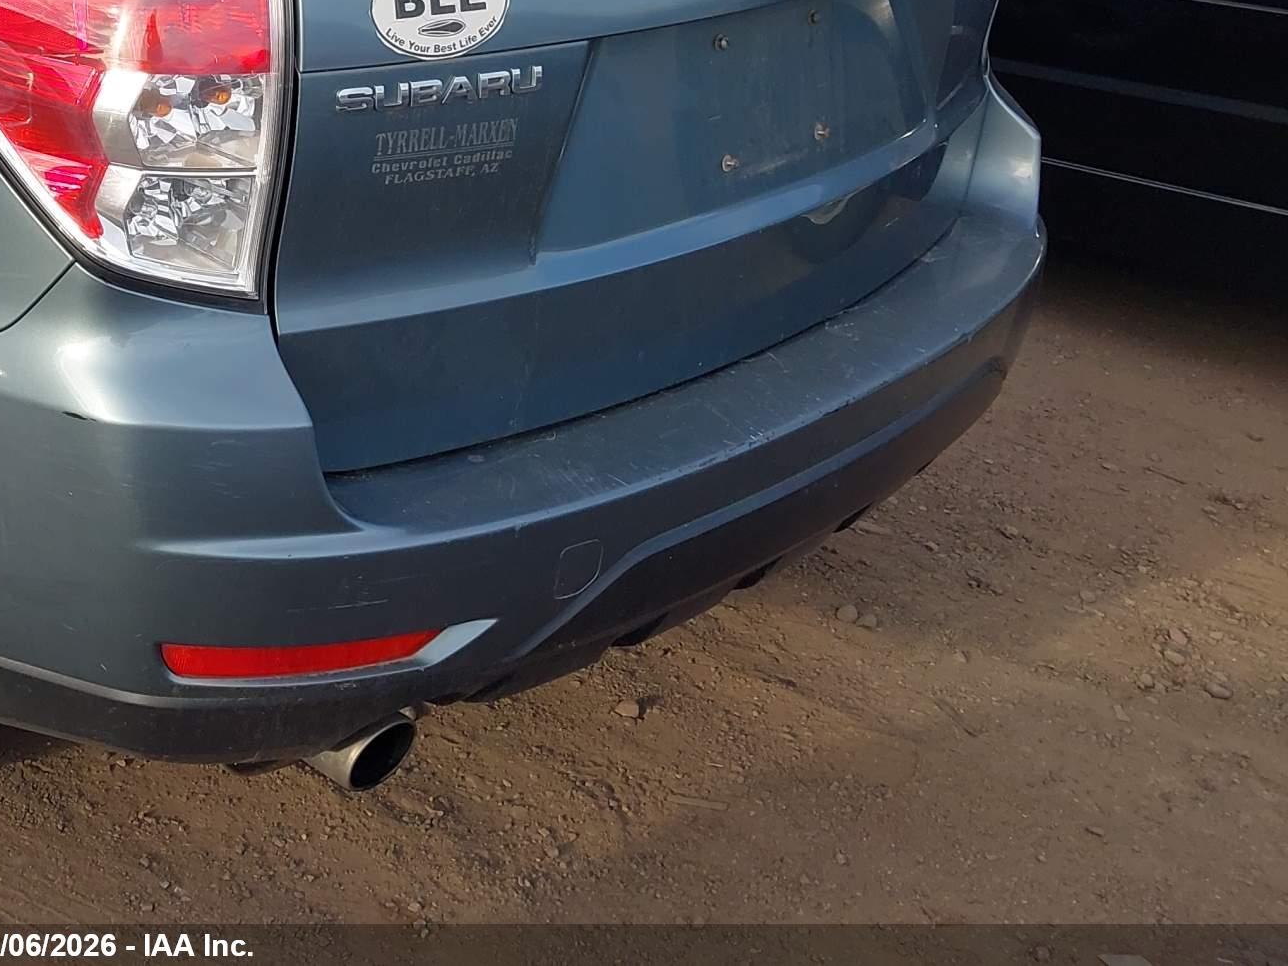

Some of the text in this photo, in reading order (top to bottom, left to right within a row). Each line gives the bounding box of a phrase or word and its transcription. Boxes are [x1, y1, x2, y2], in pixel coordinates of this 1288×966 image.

[385, 16, 498, 54] Live Your Best Life Ever
[335, 65, 543, 111] SUBARU
[375, 118, 519, 155] TYRRELL-MARXEN
[372, 149, 513, 174] Chevrolet Cadillac
[480, 162, 500, 174] AZ
